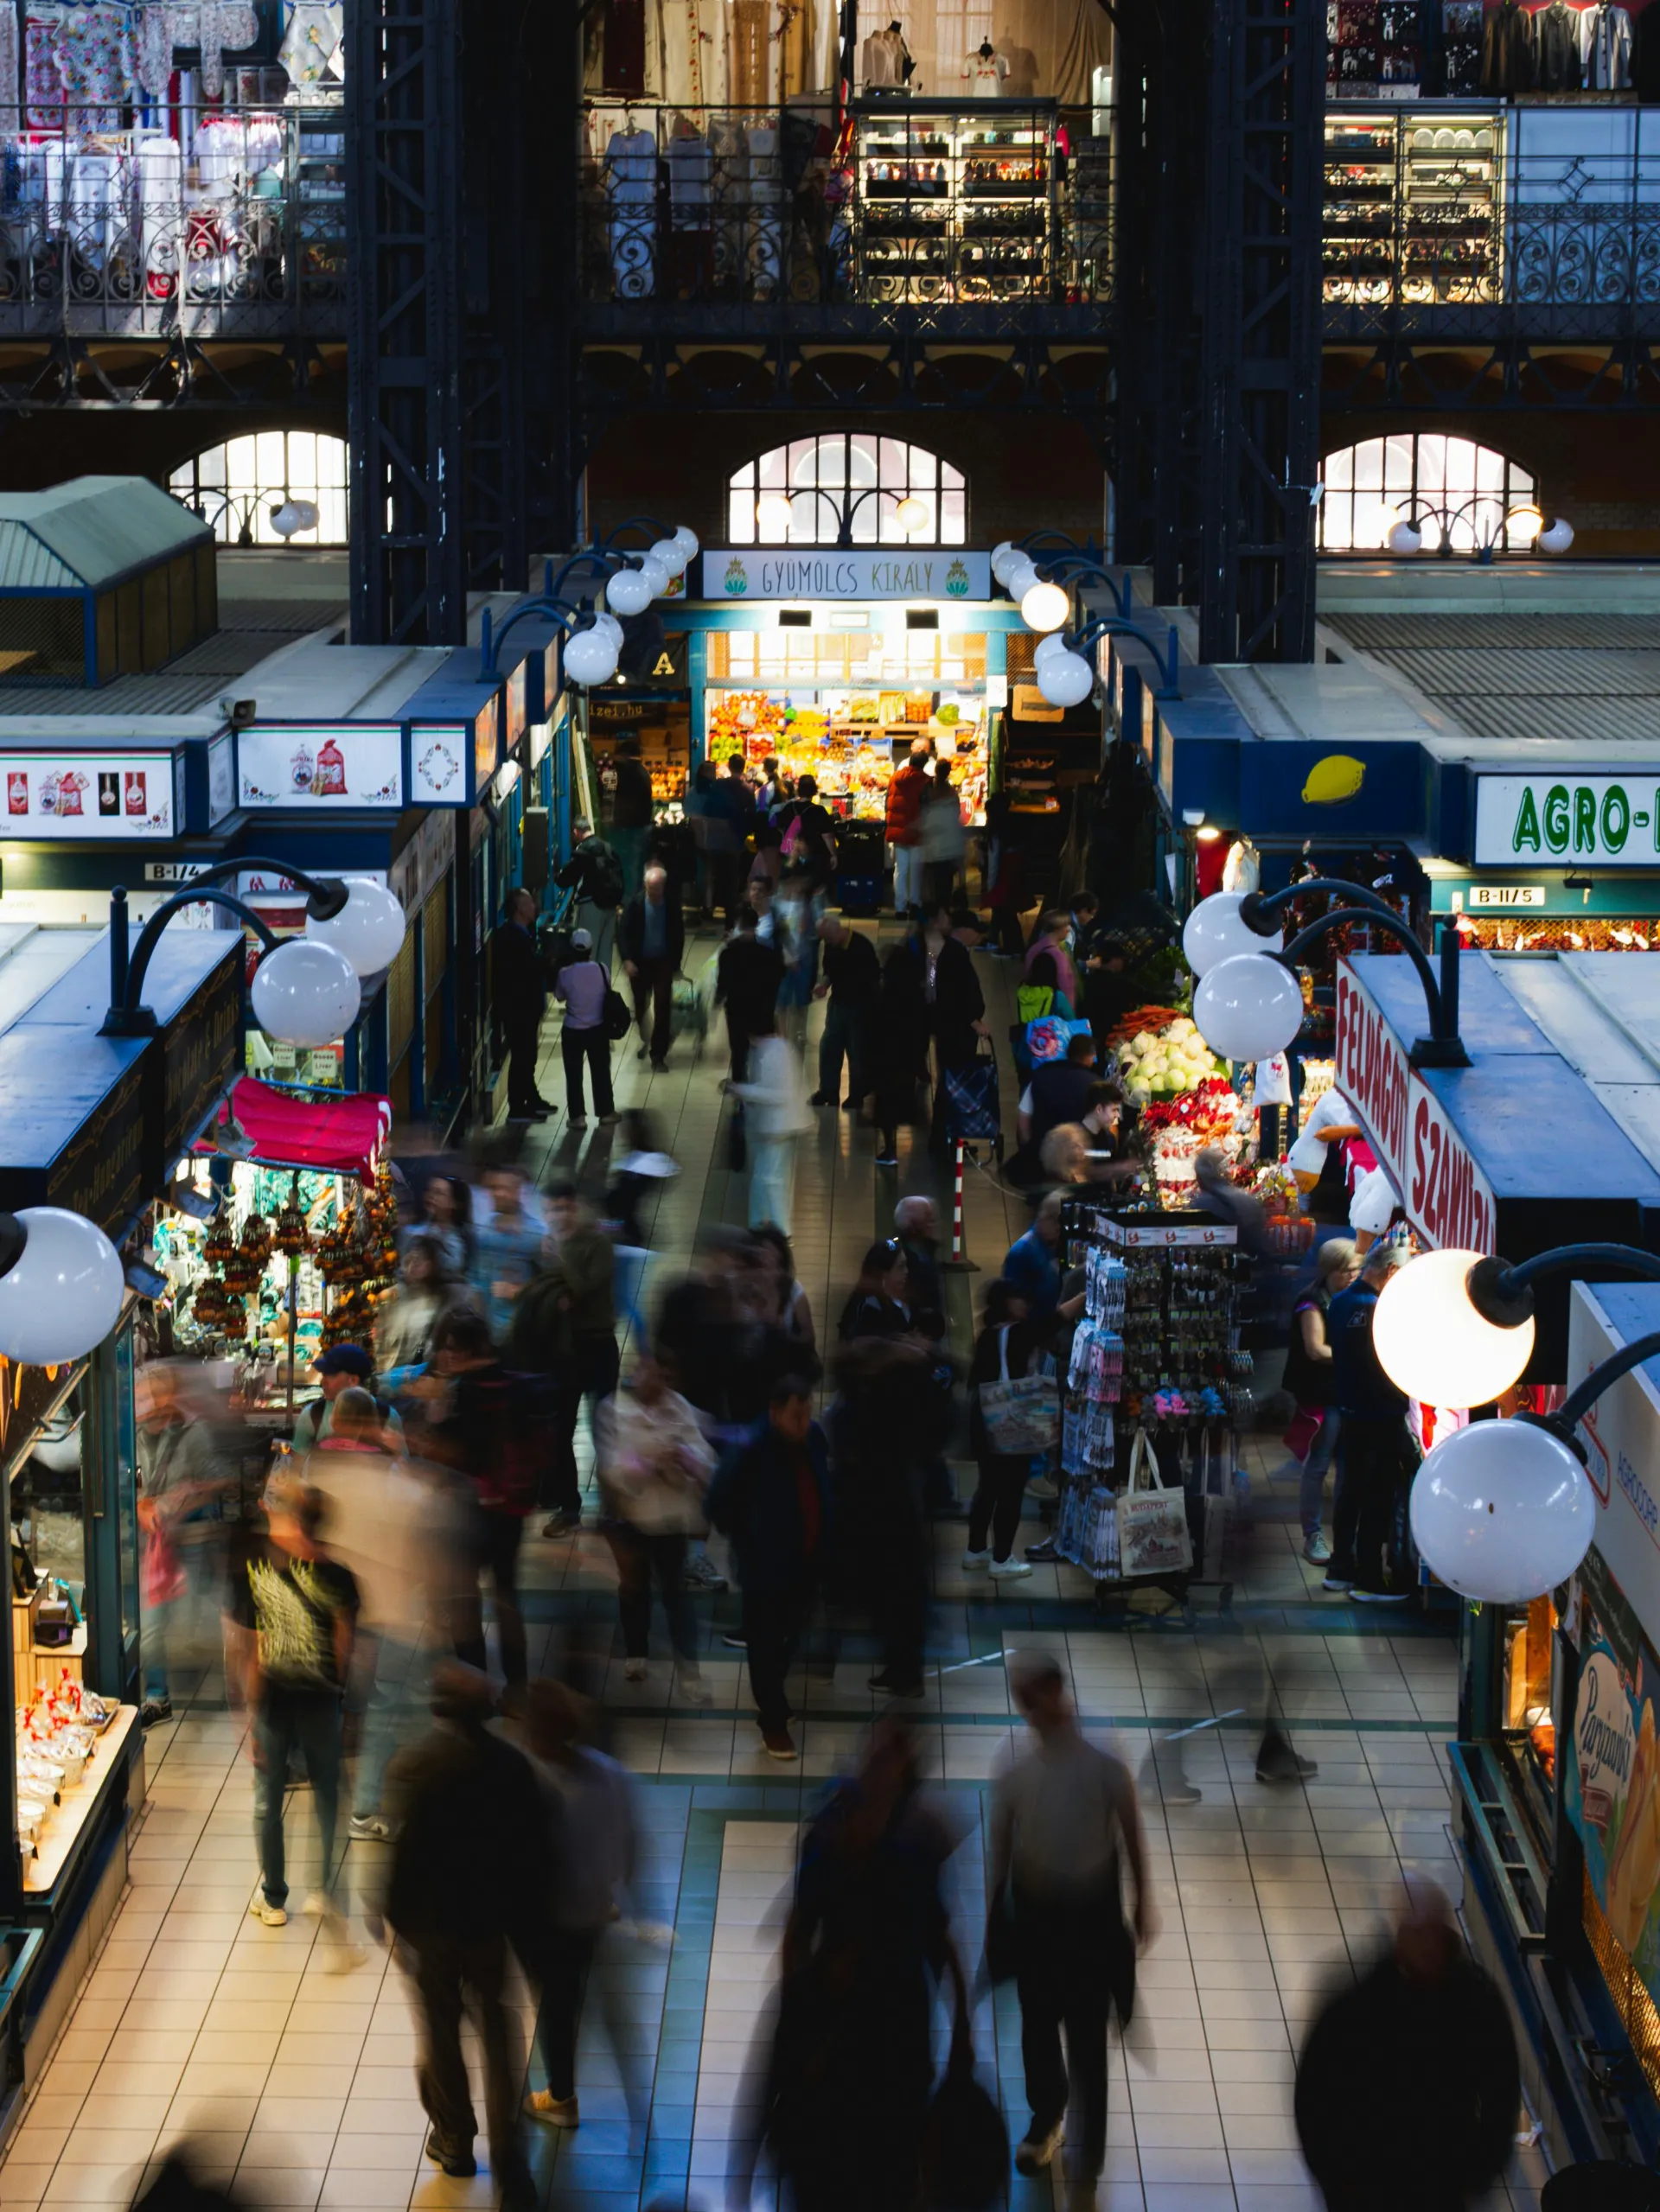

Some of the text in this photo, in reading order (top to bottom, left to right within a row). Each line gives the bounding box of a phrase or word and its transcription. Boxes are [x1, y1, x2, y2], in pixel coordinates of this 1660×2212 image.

[763, 558, 933, 594] GYÜMÖLCS KIRÁLY
[651, 651, 675, 676] A
[1512, 784, 1660, 855] AGRO-
[1130, 1501, 1168, 1513] BUDAPEST
